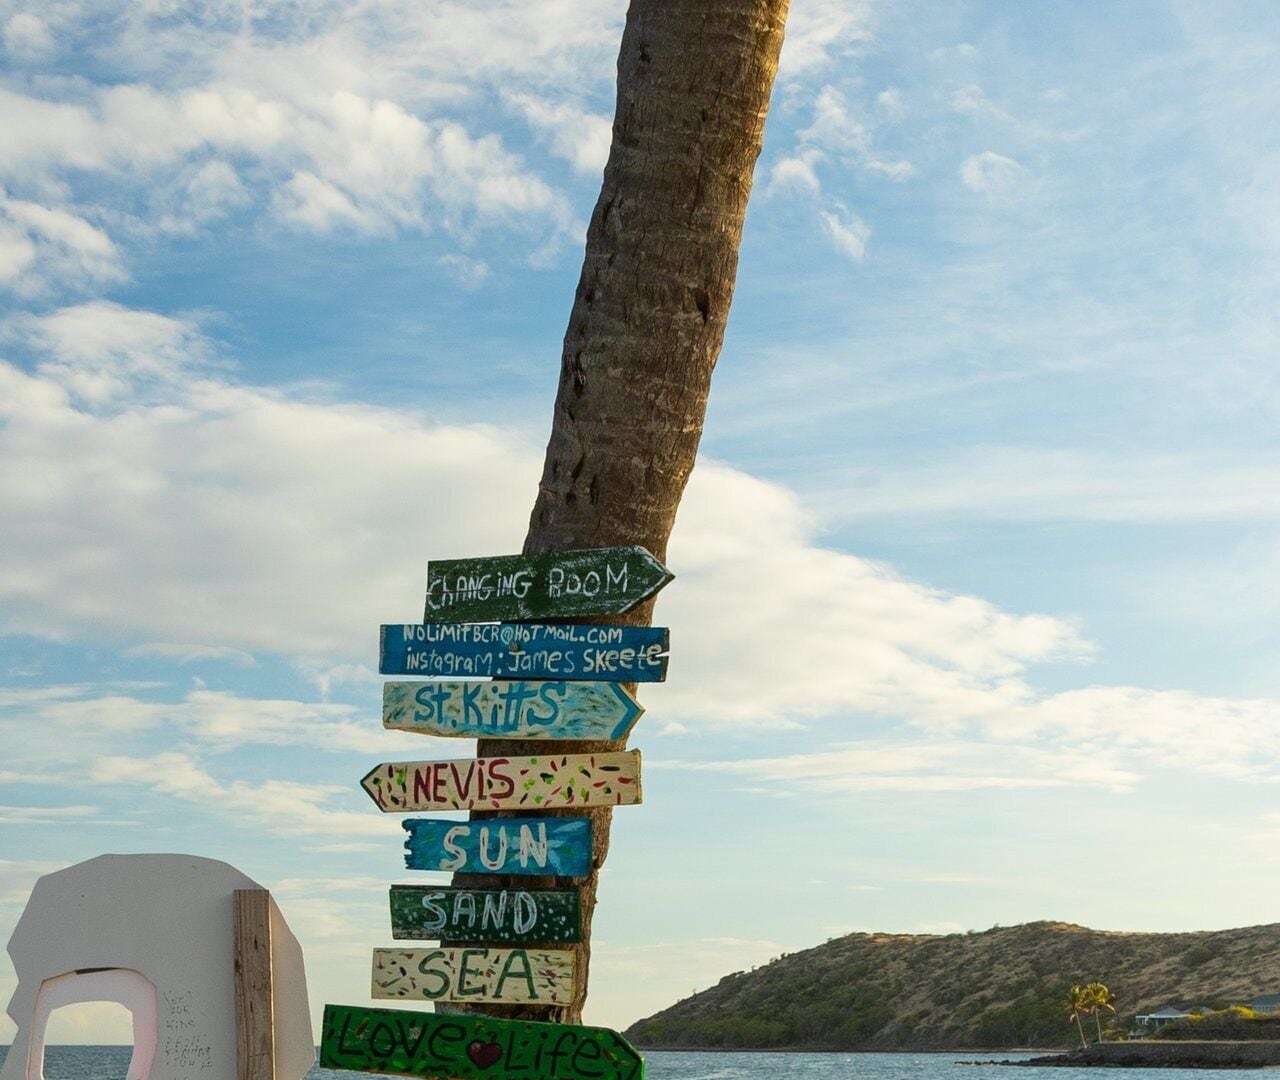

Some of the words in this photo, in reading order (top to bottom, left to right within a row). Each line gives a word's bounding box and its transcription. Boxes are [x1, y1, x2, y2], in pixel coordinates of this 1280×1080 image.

[549, 562, 628, 598] ROOM
[439, 822, 548, 871] SUN
[422, 890, 538, 934] SAND
[419, 949, 539, 1000] SEA
